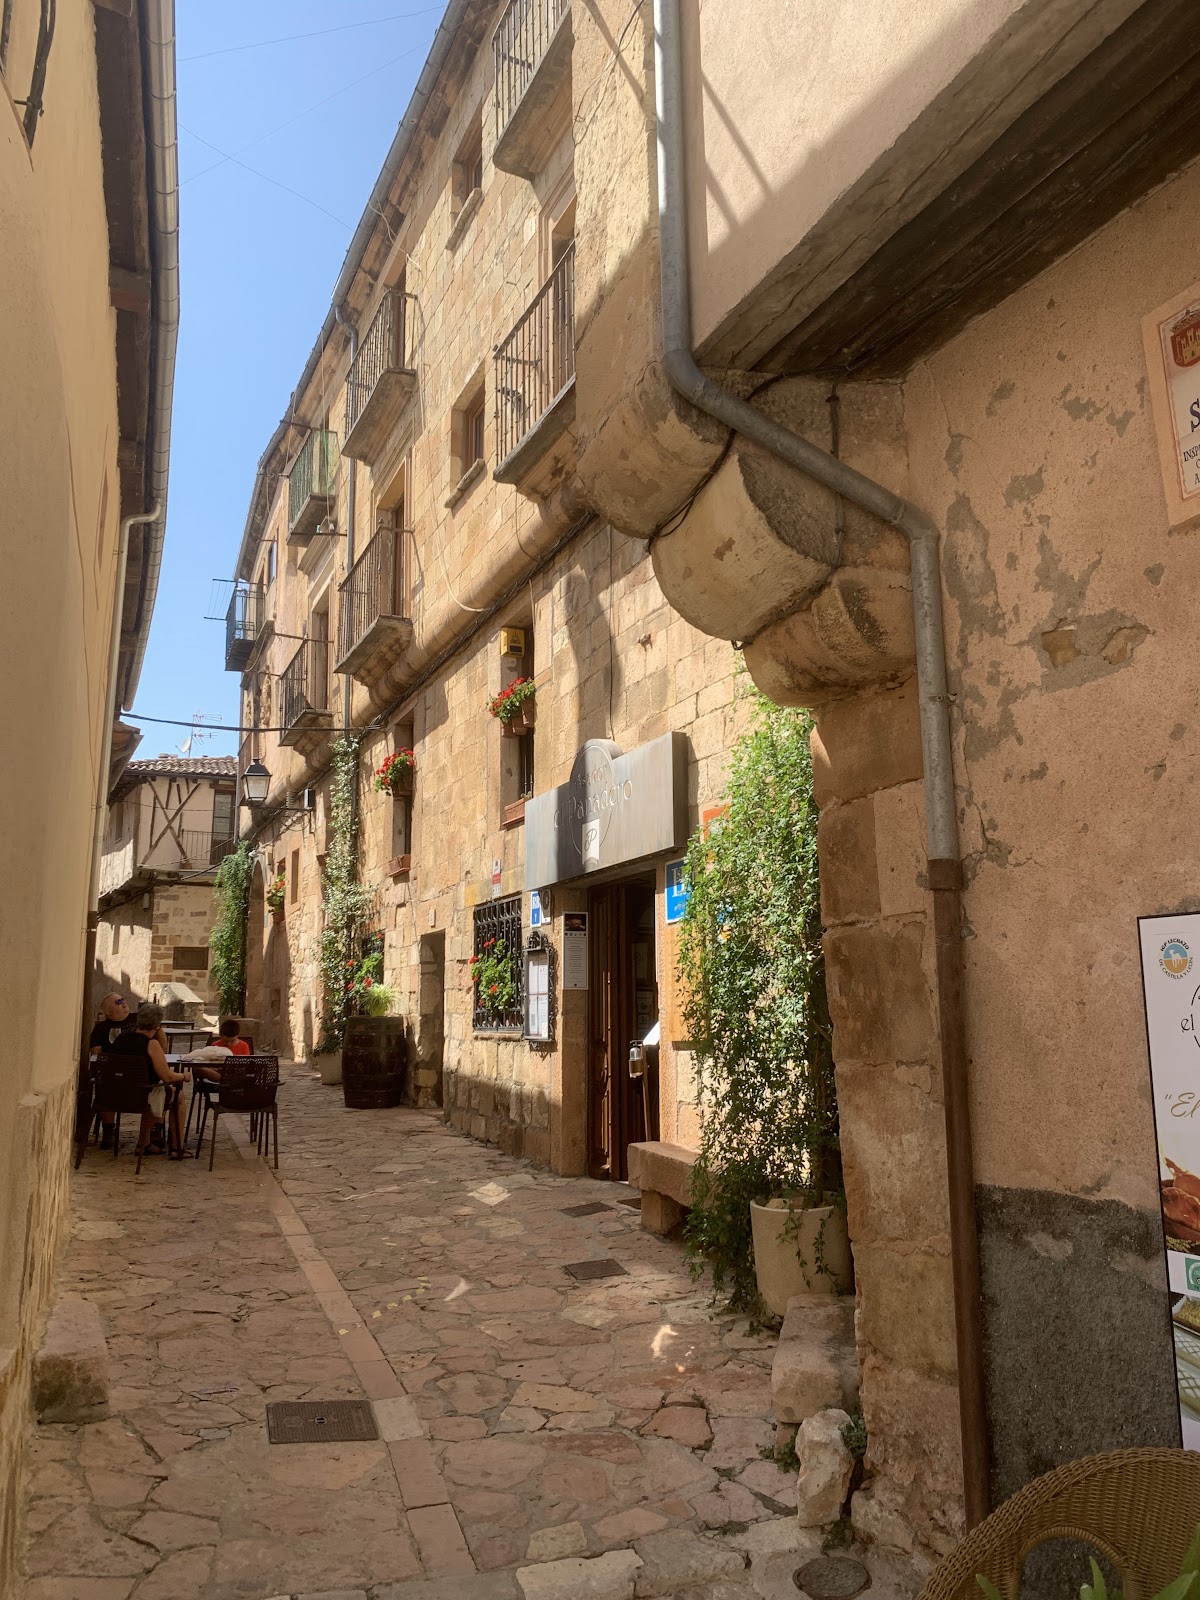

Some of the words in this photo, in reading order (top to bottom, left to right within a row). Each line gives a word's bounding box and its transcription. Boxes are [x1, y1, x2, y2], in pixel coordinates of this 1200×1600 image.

[1183, 444, 1200, 462] INSP
[567, 779, 633, 823] Panadero
[1167, 937, 1190, 950] LECHAZO
[1161, 967, 1184, 980] CASTILLA
[1181, 1013, 1194, 1033] el
